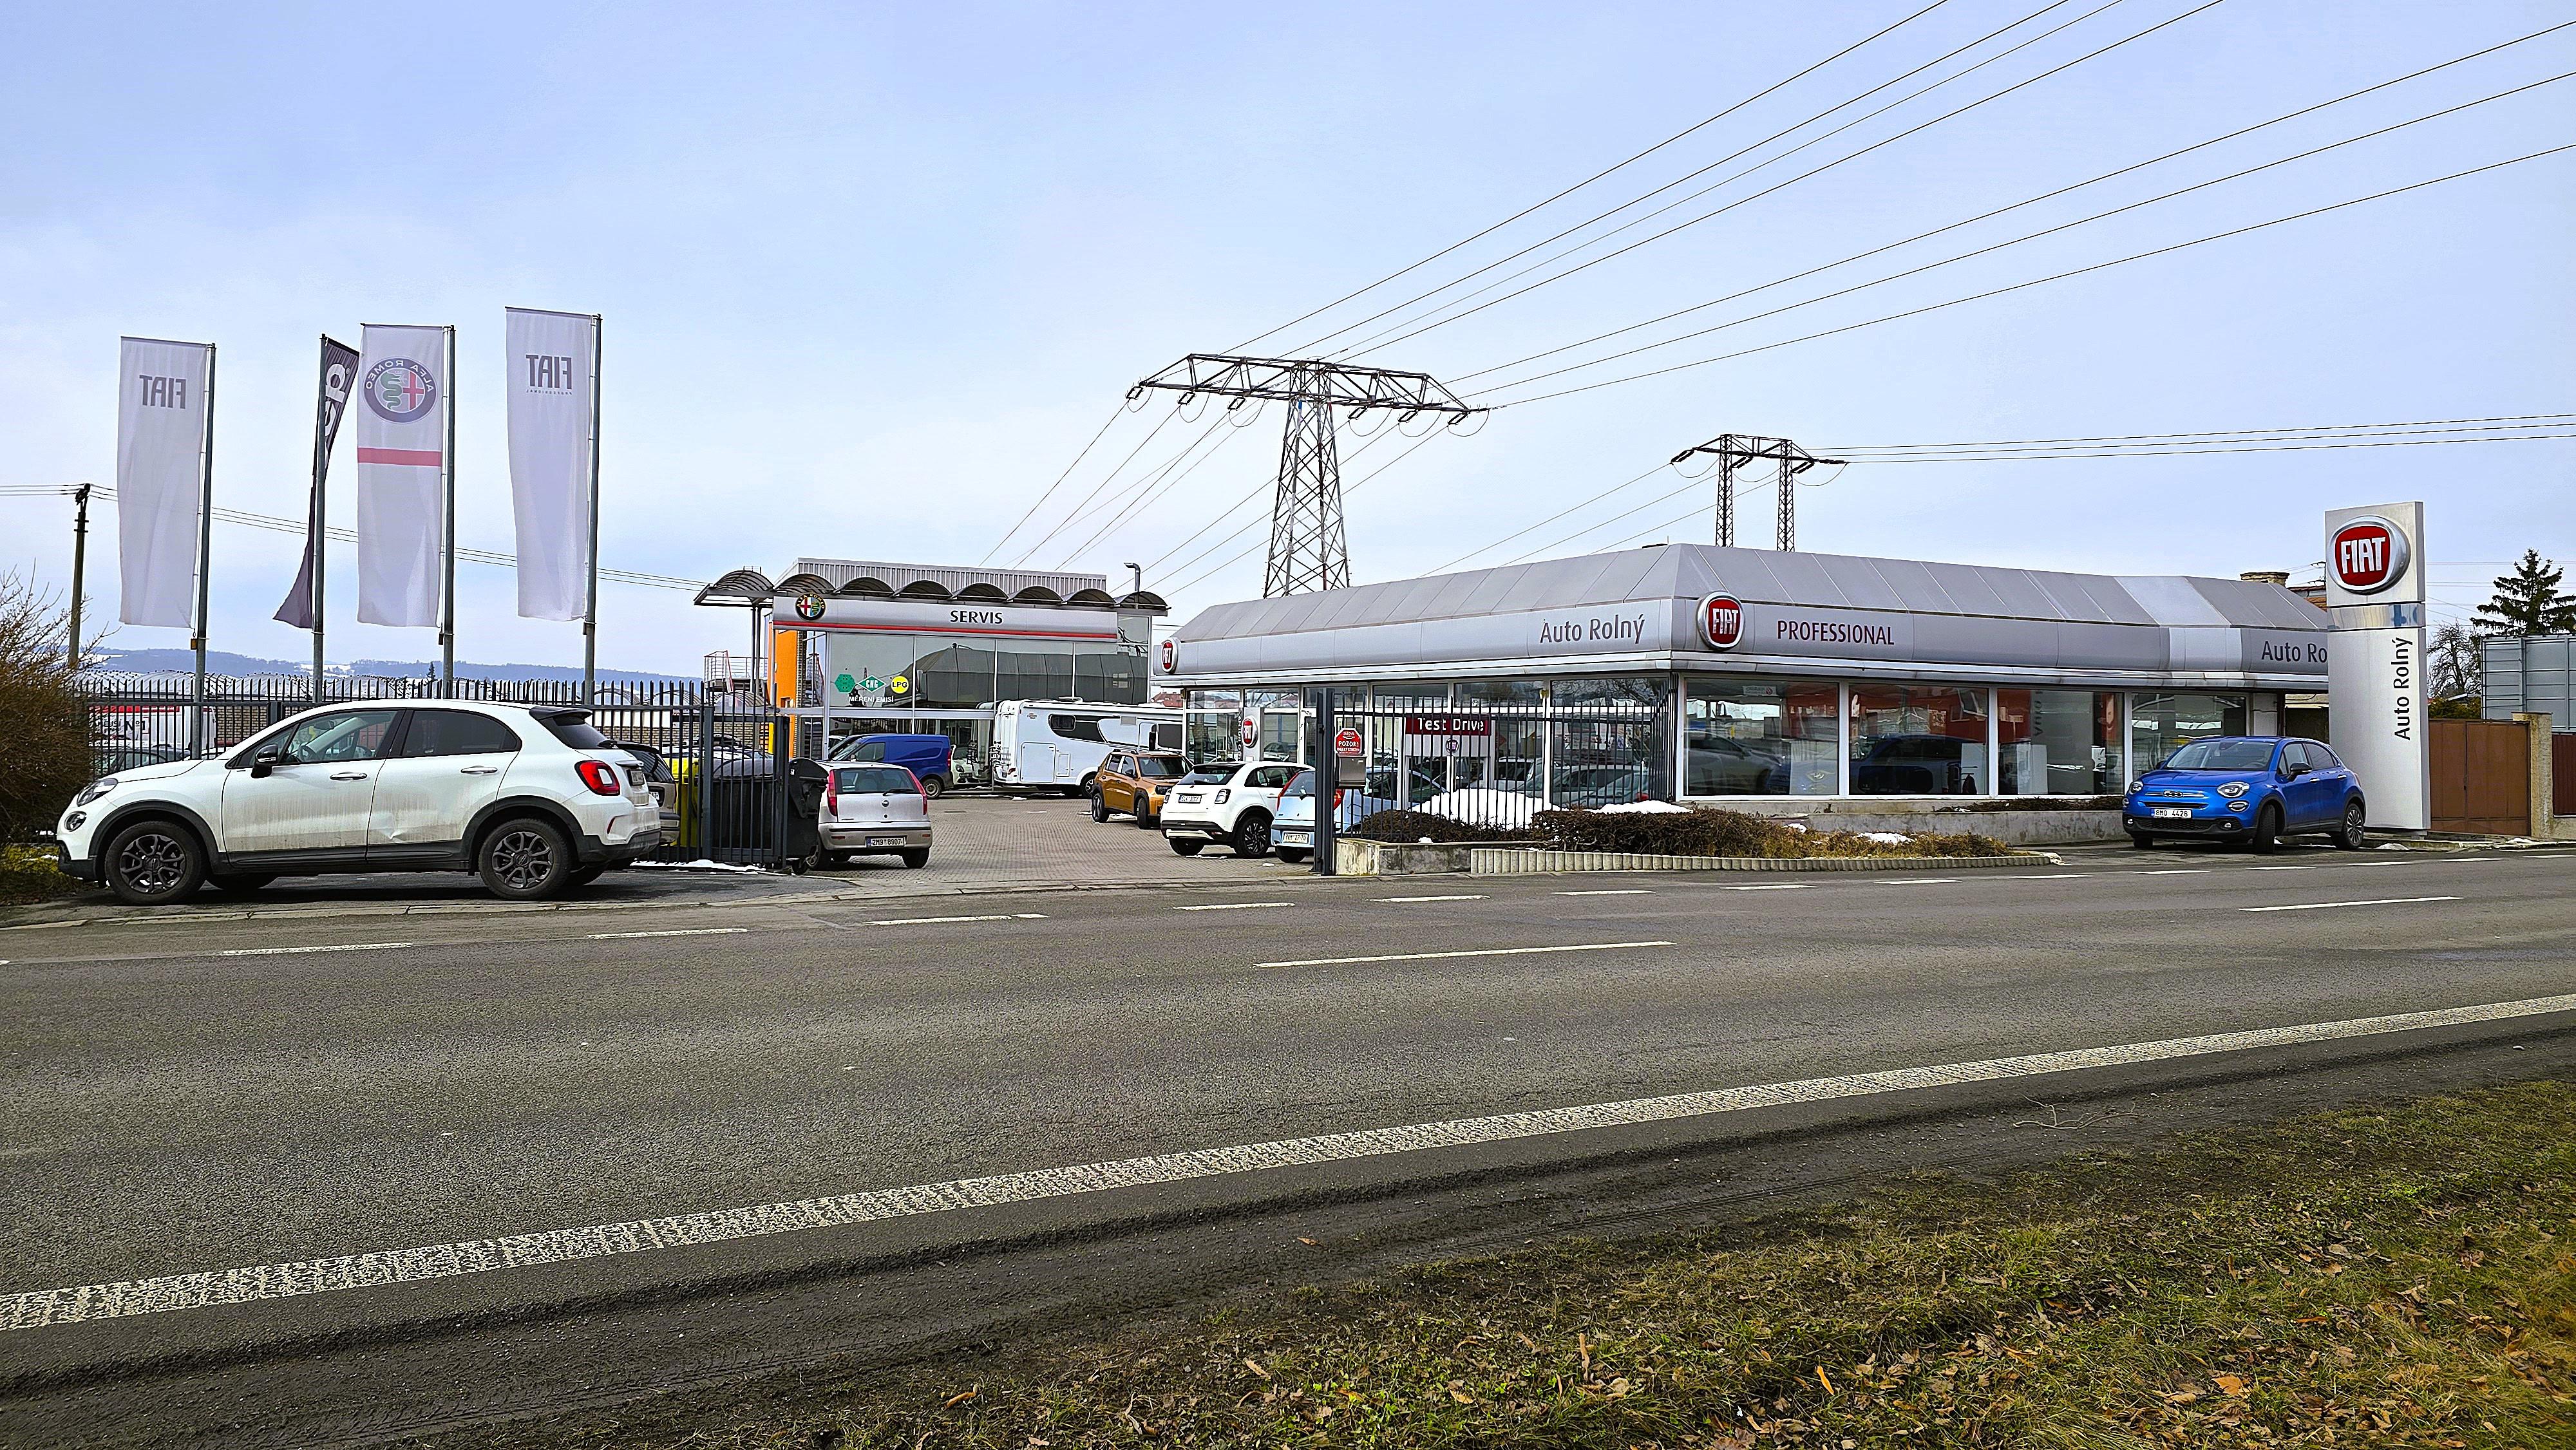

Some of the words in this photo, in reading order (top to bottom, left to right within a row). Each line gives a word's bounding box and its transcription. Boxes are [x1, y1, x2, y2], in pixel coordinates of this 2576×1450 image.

[2340, 536, 2386, 574] FIAT
[950, 610, 1003, 624] SERVIS
[1540, 621, 1582, 643] Auto
[1589, 614, 1645, 645] Rolný
[1712, 608, 1739, 635] FIAT
[1777, 620, 1895, 645] PROFESSIONAL
[2261, 641, 2301, 663] Auto
[2391, 637, 2413, 689] Rolný
[866, 679, 878, 688] CNG
[1417, 717, 1446, 731] Test
[1453, 719, 1484, 731] Drive
[2394, 696, 2410, 741] Auto
